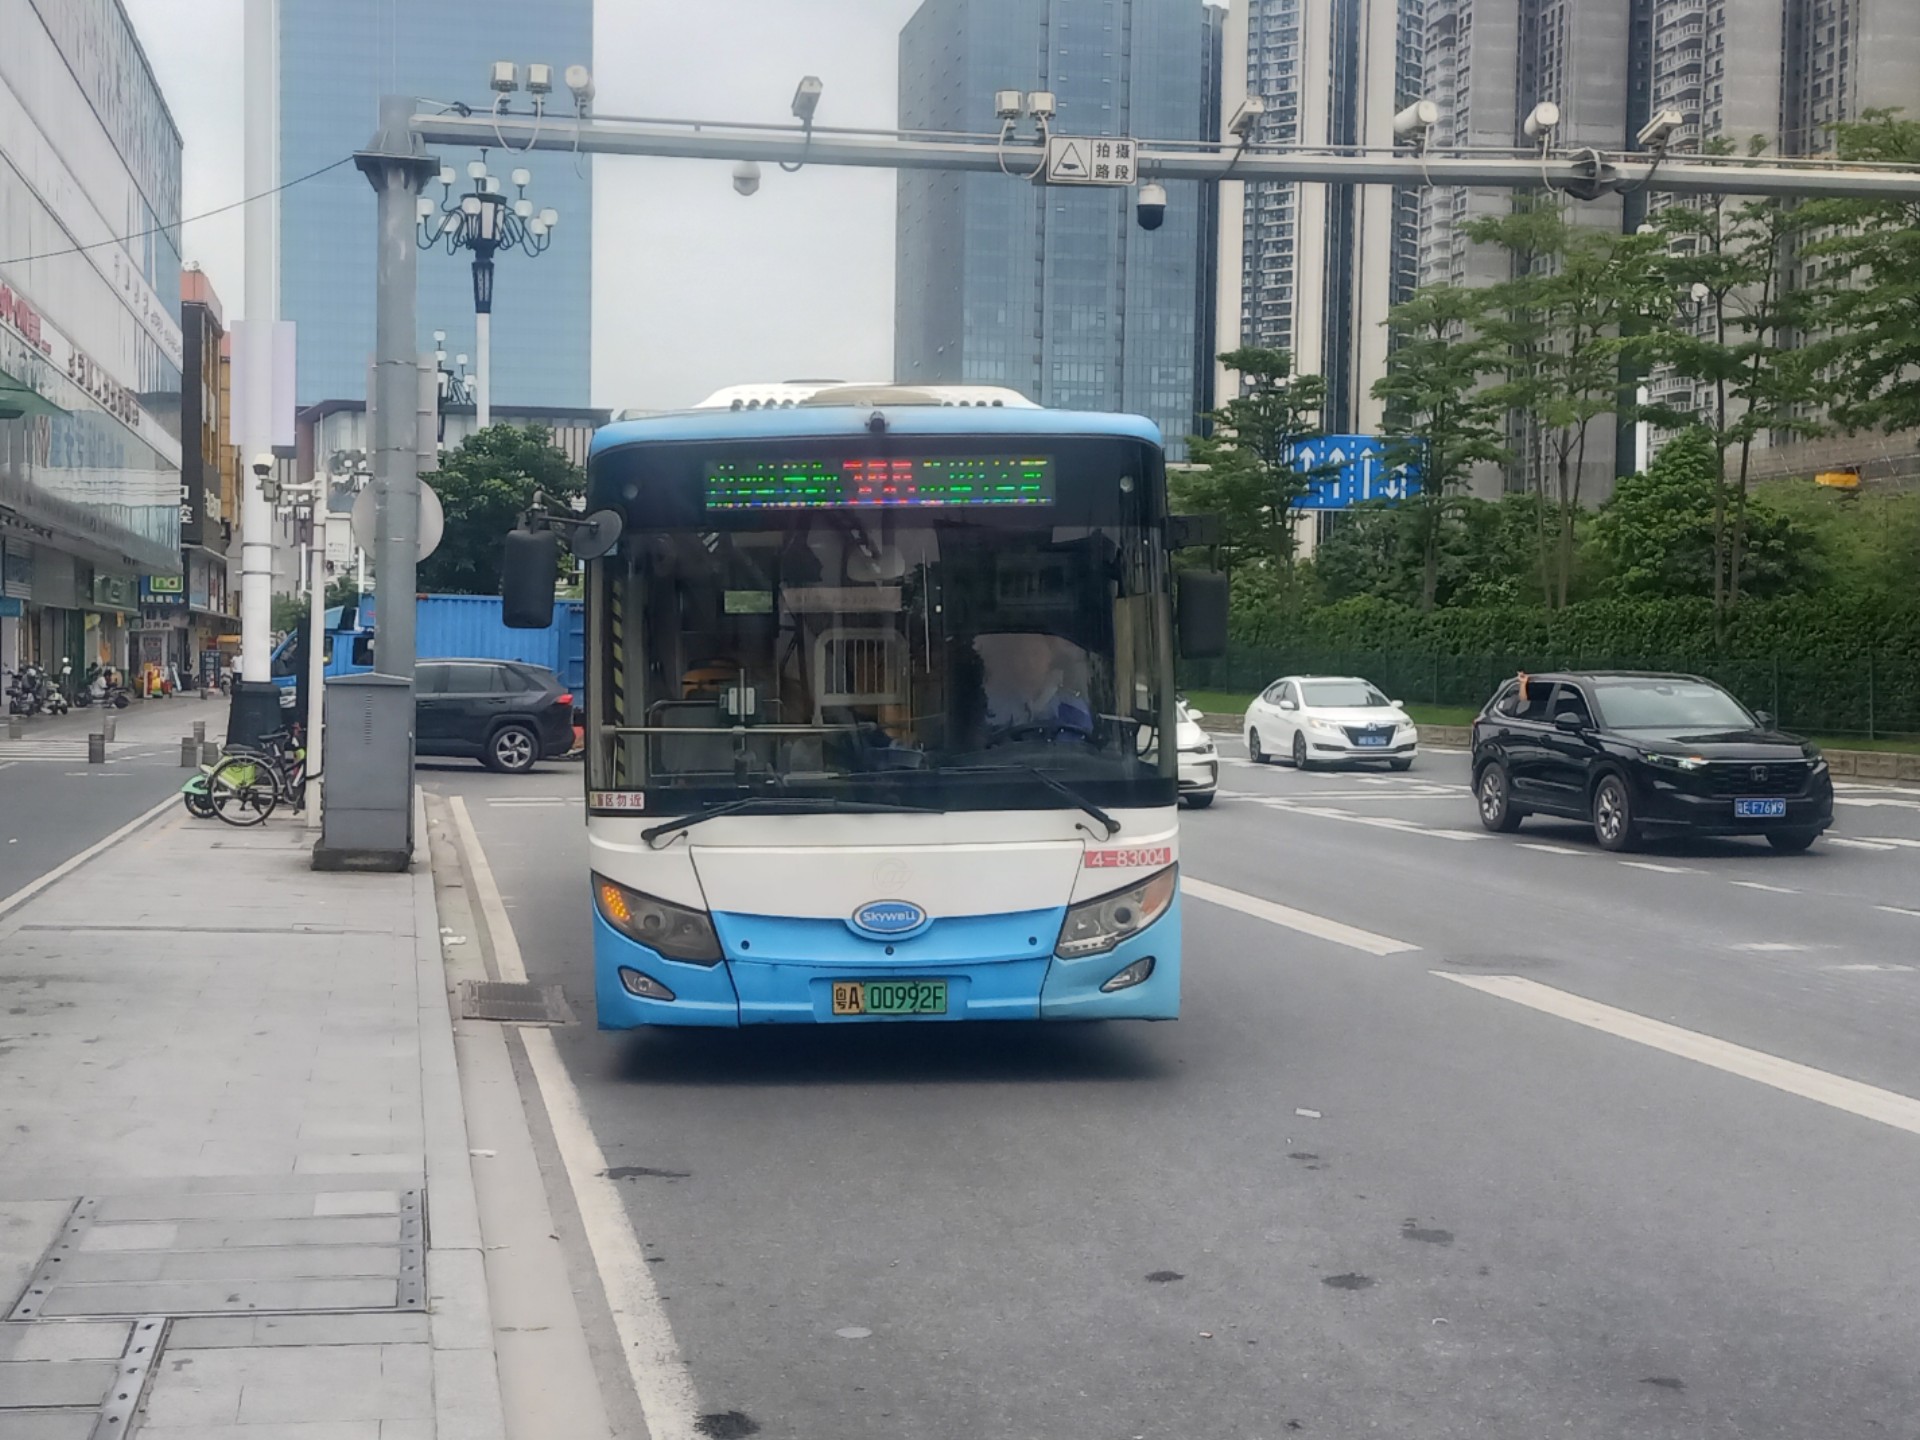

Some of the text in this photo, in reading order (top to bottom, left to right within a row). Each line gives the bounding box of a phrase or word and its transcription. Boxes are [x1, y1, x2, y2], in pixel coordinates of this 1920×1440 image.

[1096, 142, 1130, 159] 拍摄
[1095, 164, 1129, 180] 路段
[1091, 848, 1165, 867] 4-83004
[862, 910, 917, 923] Skywell
[870, 986, 944, 1009] 00992F
